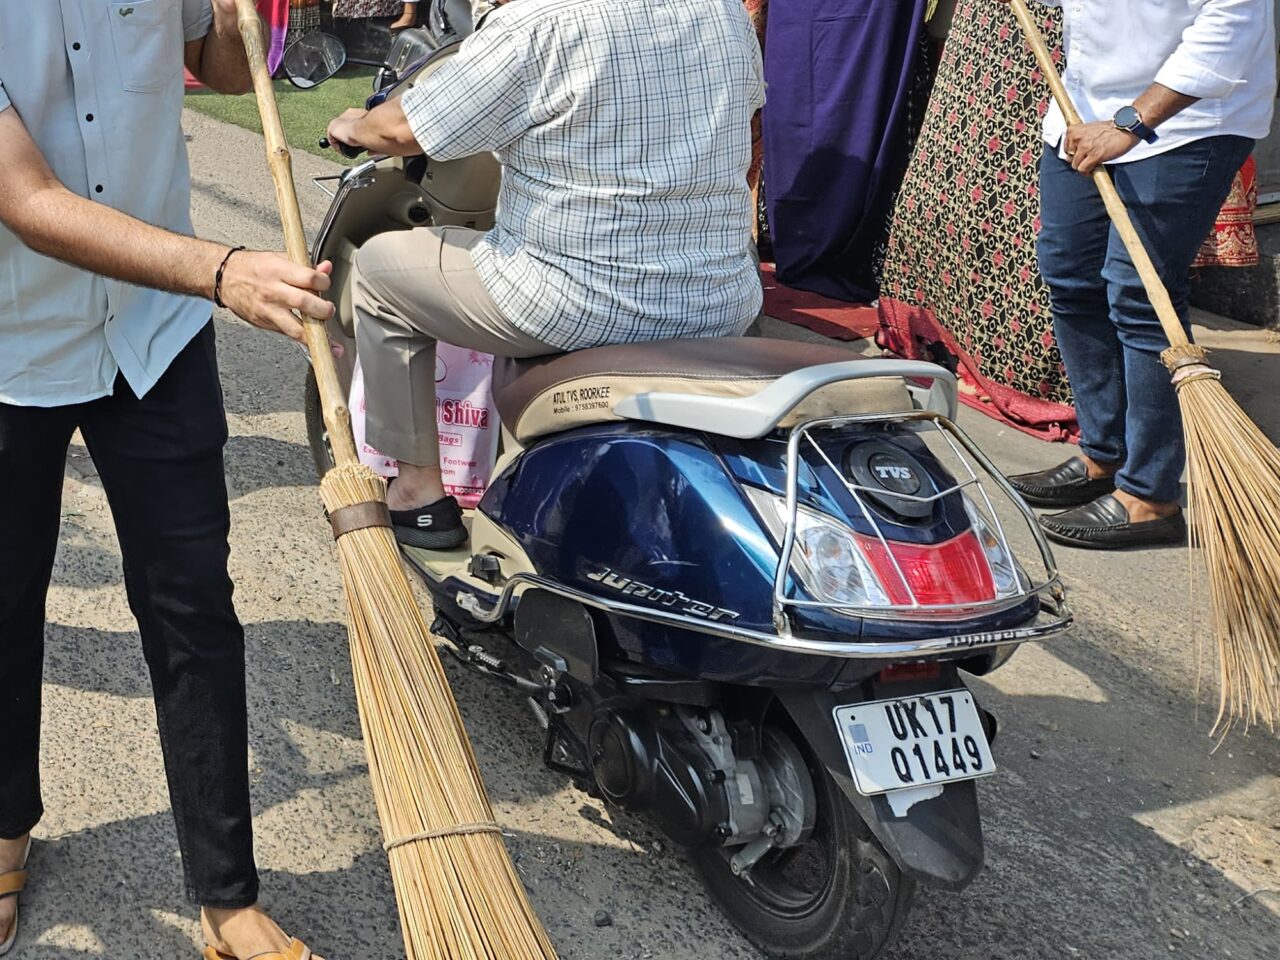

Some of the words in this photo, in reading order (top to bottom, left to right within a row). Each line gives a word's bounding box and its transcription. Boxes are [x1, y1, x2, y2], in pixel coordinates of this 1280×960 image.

[580, 386, 610, 400] ROORKEE
[443, 399, 488, 429] Shiva
[874, 466, 911, 479] TVS
[885, 696, 956, 740] UK17
[854, 743, 873, 755] IND
